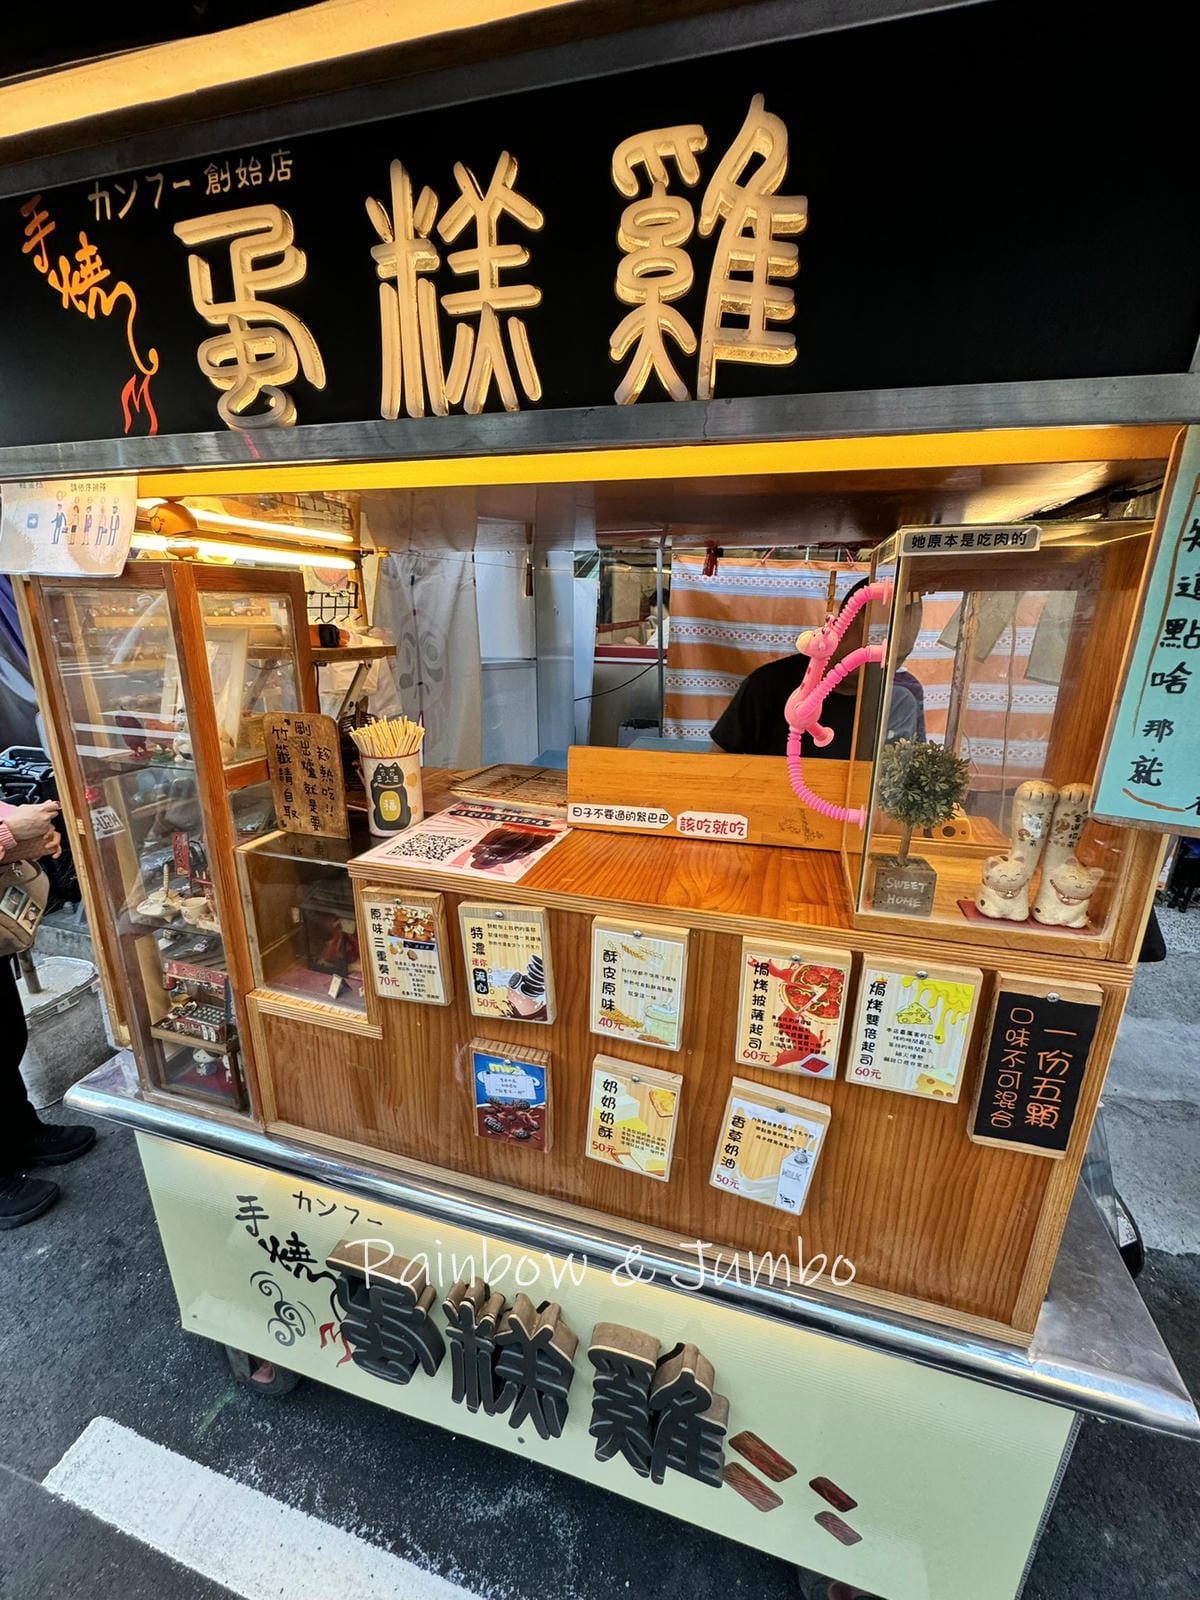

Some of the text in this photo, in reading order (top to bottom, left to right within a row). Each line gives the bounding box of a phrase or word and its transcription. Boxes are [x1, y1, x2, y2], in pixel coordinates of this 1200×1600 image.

[205, 150, 293, 196] 創始店
[174, 93, 808, 430] 蛋糕雞
[911, 530, 1028, 549] 她原本是吃肉的
[295, 721, 321, 831] 剛出爐就是要
[383, 799, 398, 811] 福
[572, 806, 669, 824] 日子不要過的緊巴巴
[680, 816, 745, 837] 該吃就吃
[886, 877, 927, 893] SWEET
[887, 894, 921, 907] HOME
[371, 908, 389, 974] 原味三重奏
[378, 976, 400, 987] 70元
[601, 949, 618, 1011] 酥皮原味
[477, 998, 498, 1009] 50元
[749, 962, 769, 1050] 焗烤披薩起司
[598, 1017, 624, 1032] 40元
[860, 981, 886, 1066] 焗烤雙倍起司
[743, 1050, 770, 1063] 60元
[855, 1067, 882, 1080] 60元
[990, 1006, 1035, 1129] 口味不可混合
[1024, 1027, 1078, 1130] 一份五顆
[598, 1079, 618, 1140] 奶奶奶酥
[592, 1140, 617, 1153] 50元
[721, 1115, 746, 1169] 香草奶油
[715, 1174, 740, 1190] 50元
